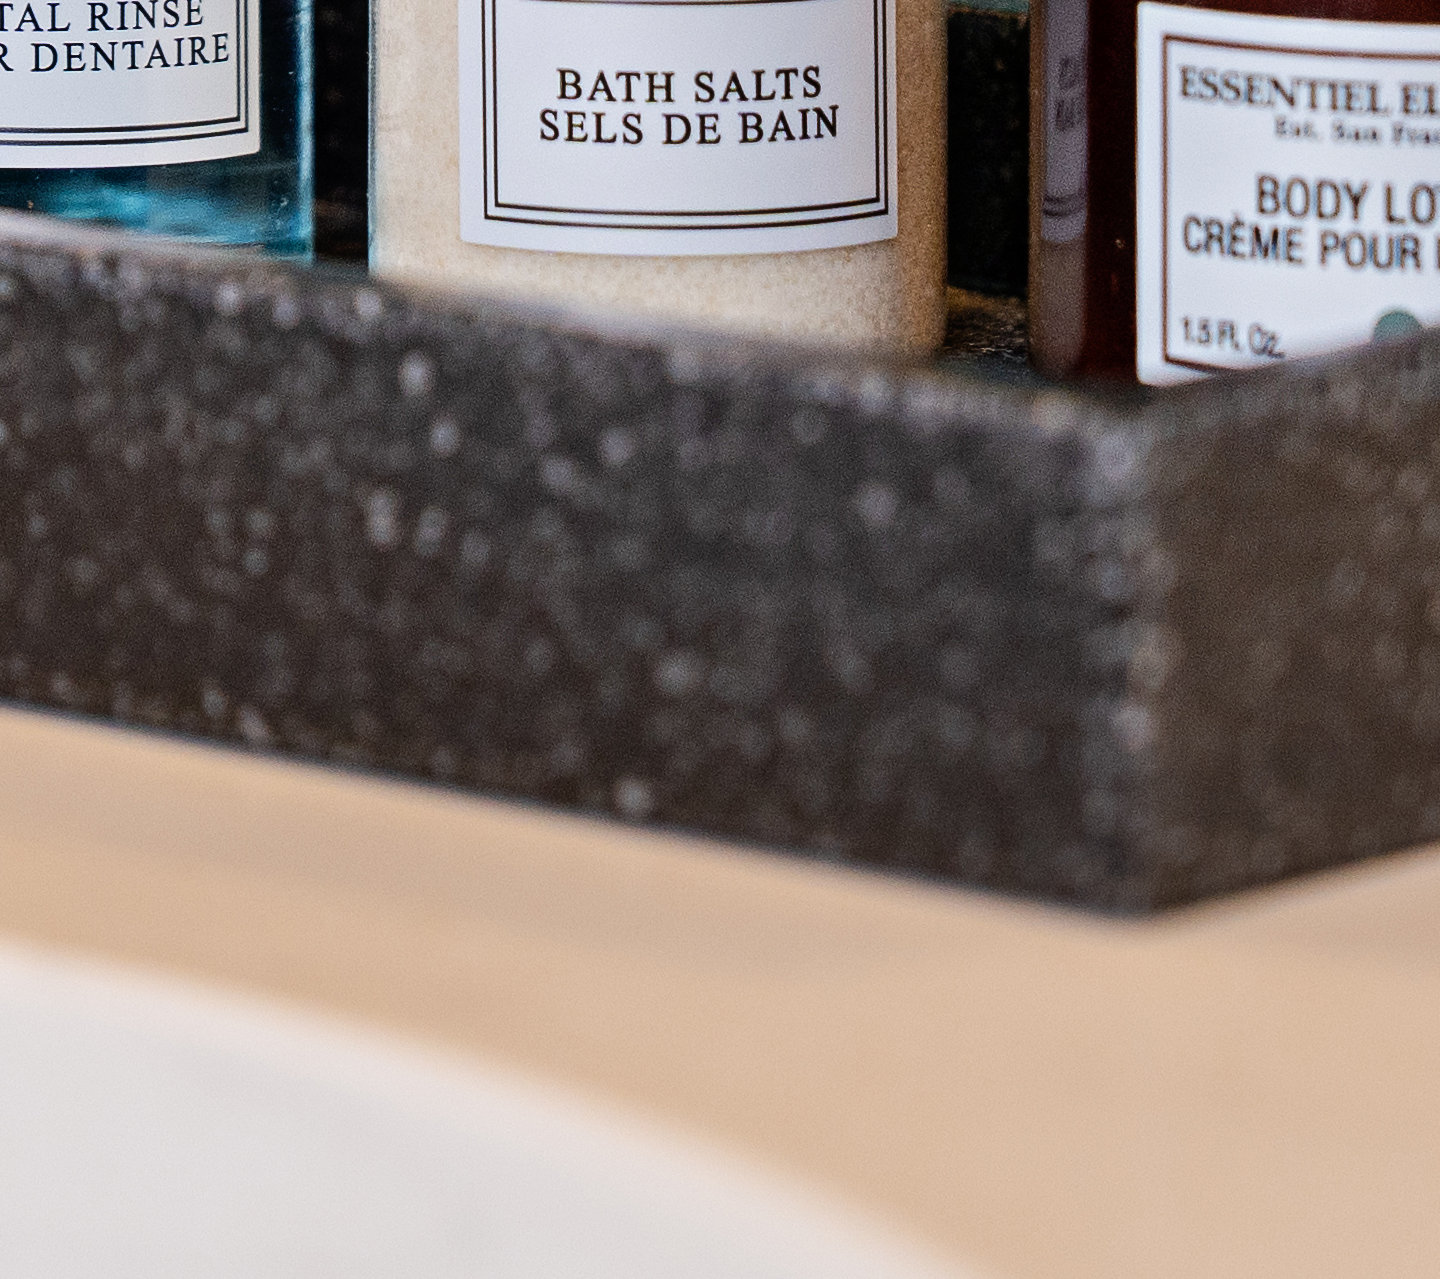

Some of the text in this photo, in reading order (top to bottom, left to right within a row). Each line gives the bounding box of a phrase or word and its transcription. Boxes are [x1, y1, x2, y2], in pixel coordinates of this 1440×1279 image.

[30, 32, 230, 73] DENTAIRE
[557, 64, 823, 104] BATH SALTS
[1178, 64, 1389, 115] ESSENTIEL
[539, 104, 840, 146] SELS DE BAIN
[1273, 114, 1319, 141] Est.
[1331, 120, 1383, 145] San
[1254, 173, 1368, 221] BODY
[1181, 211, 1305, 265] CRÈME
[1320, 229, 1421, 272] POUR
